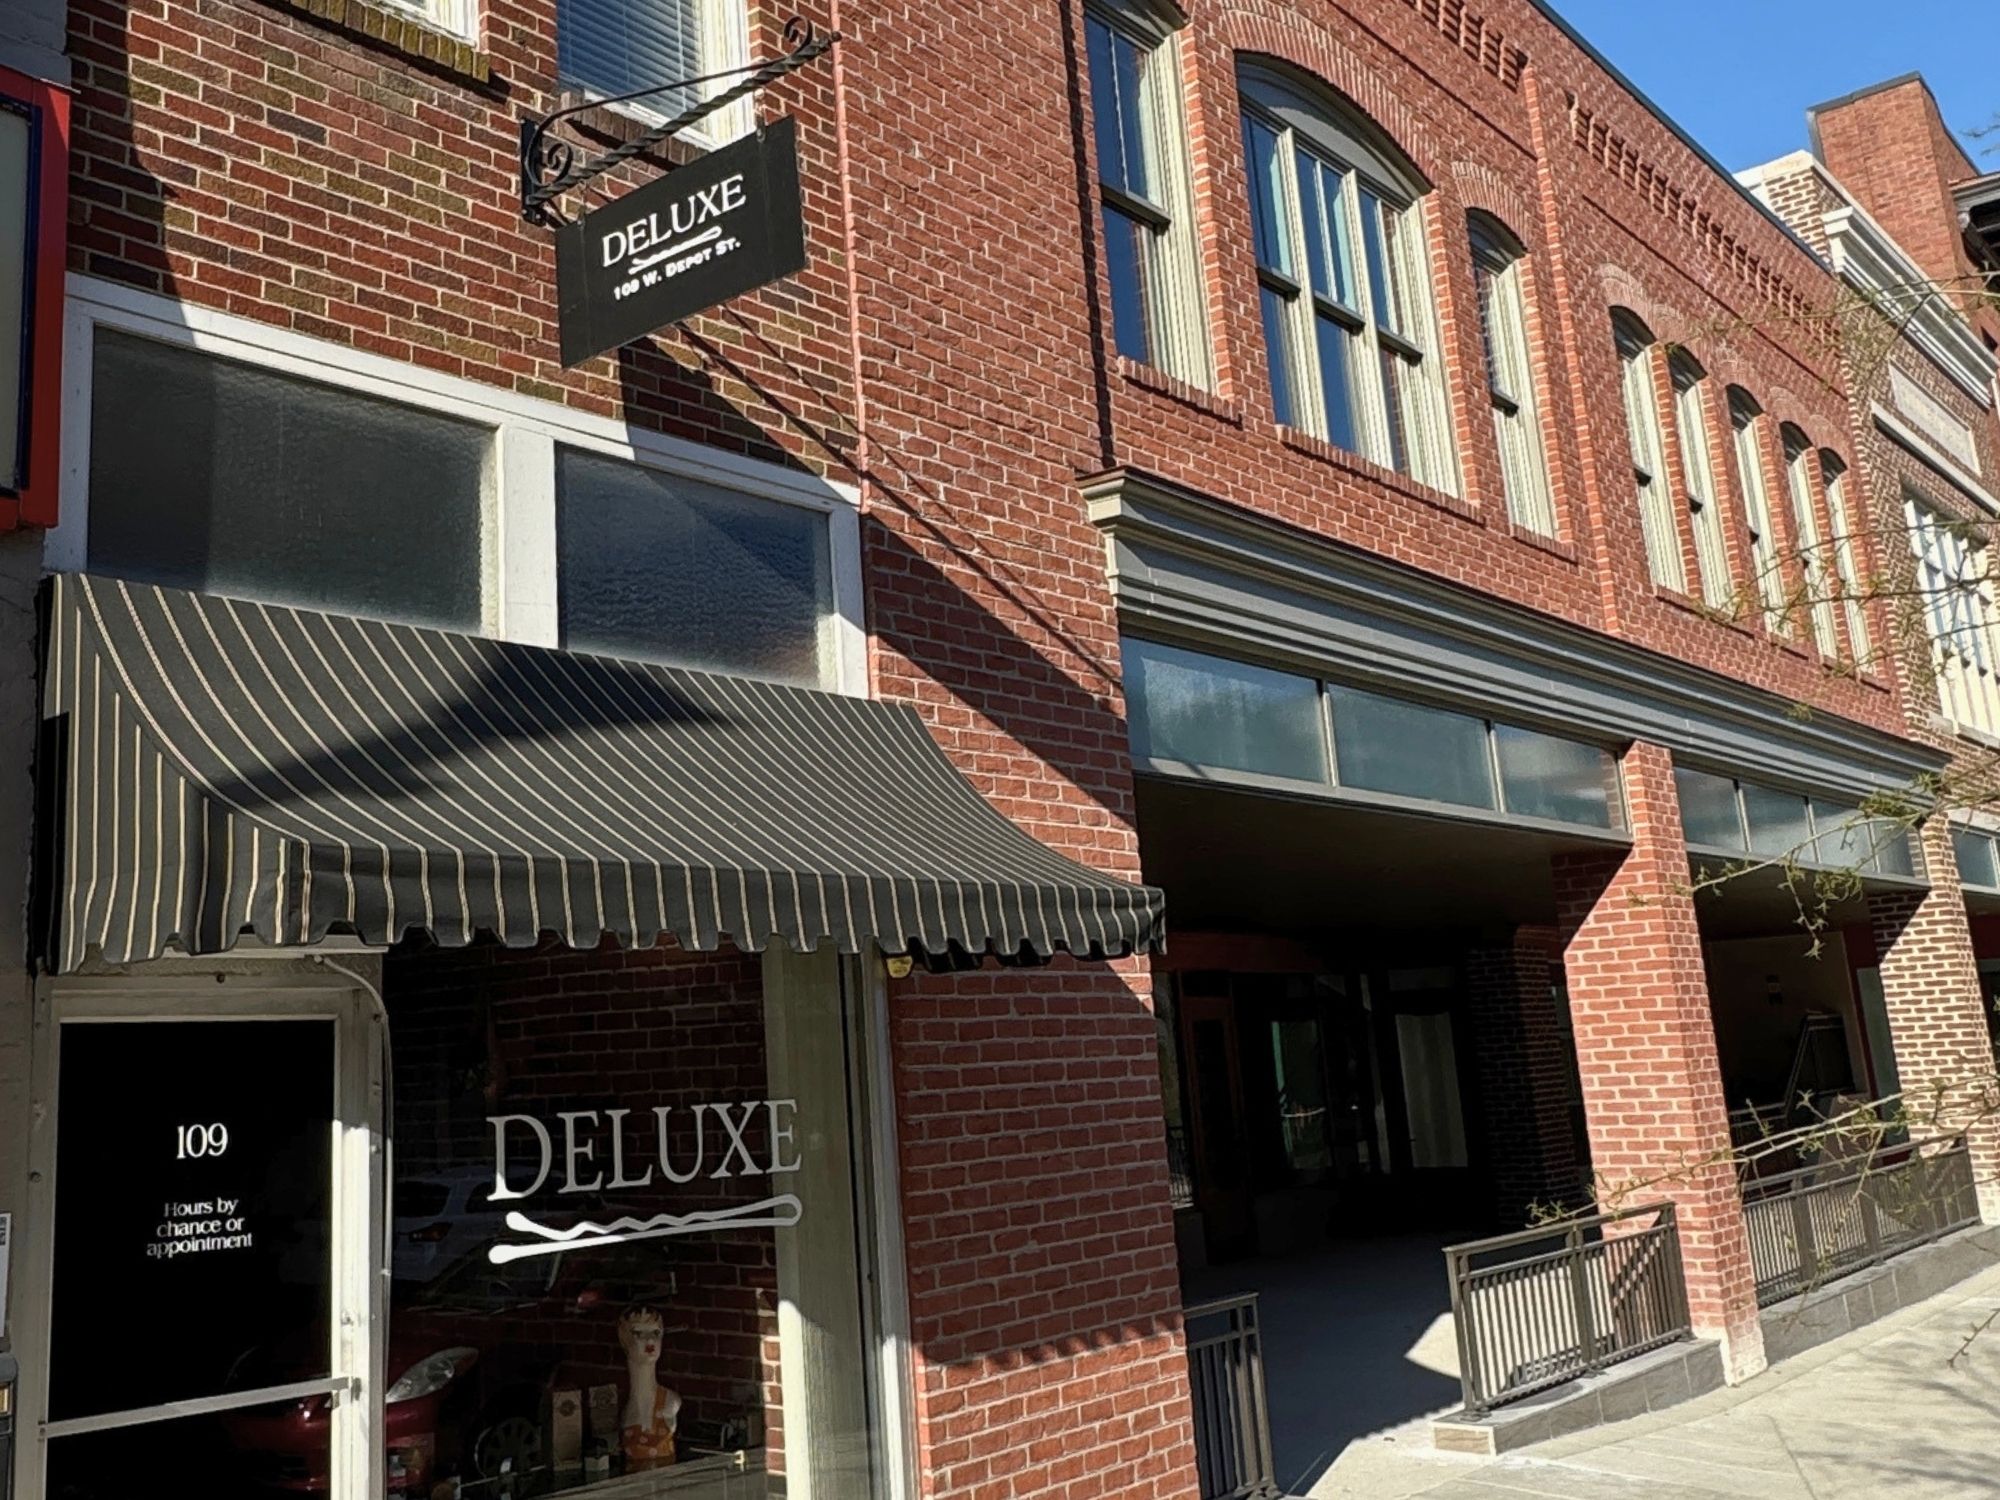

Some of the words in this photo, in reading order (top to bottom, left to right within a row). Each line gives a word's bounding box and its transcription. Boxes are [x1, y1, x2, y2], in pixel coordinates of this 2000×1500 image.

[602, 174, 746, 268] DELUXE
[614, 278, 640, 300] 109
[642, 270, 662, 287] W.
[665, 247, 712, 277] DEPOT
[715, 237, 741, 256] ST.
[176, 1122, 229, 1159] 109
[486, 1099, 801, 1201] DELUXE
[163, 1201, 214, 1217] Hours
[216, 1196, 239, 1216] by
[146, 1232, 252, 1259] appointment
[156, 1219, 222, 1238] chance
[225, 1217, 245, 1232] or
